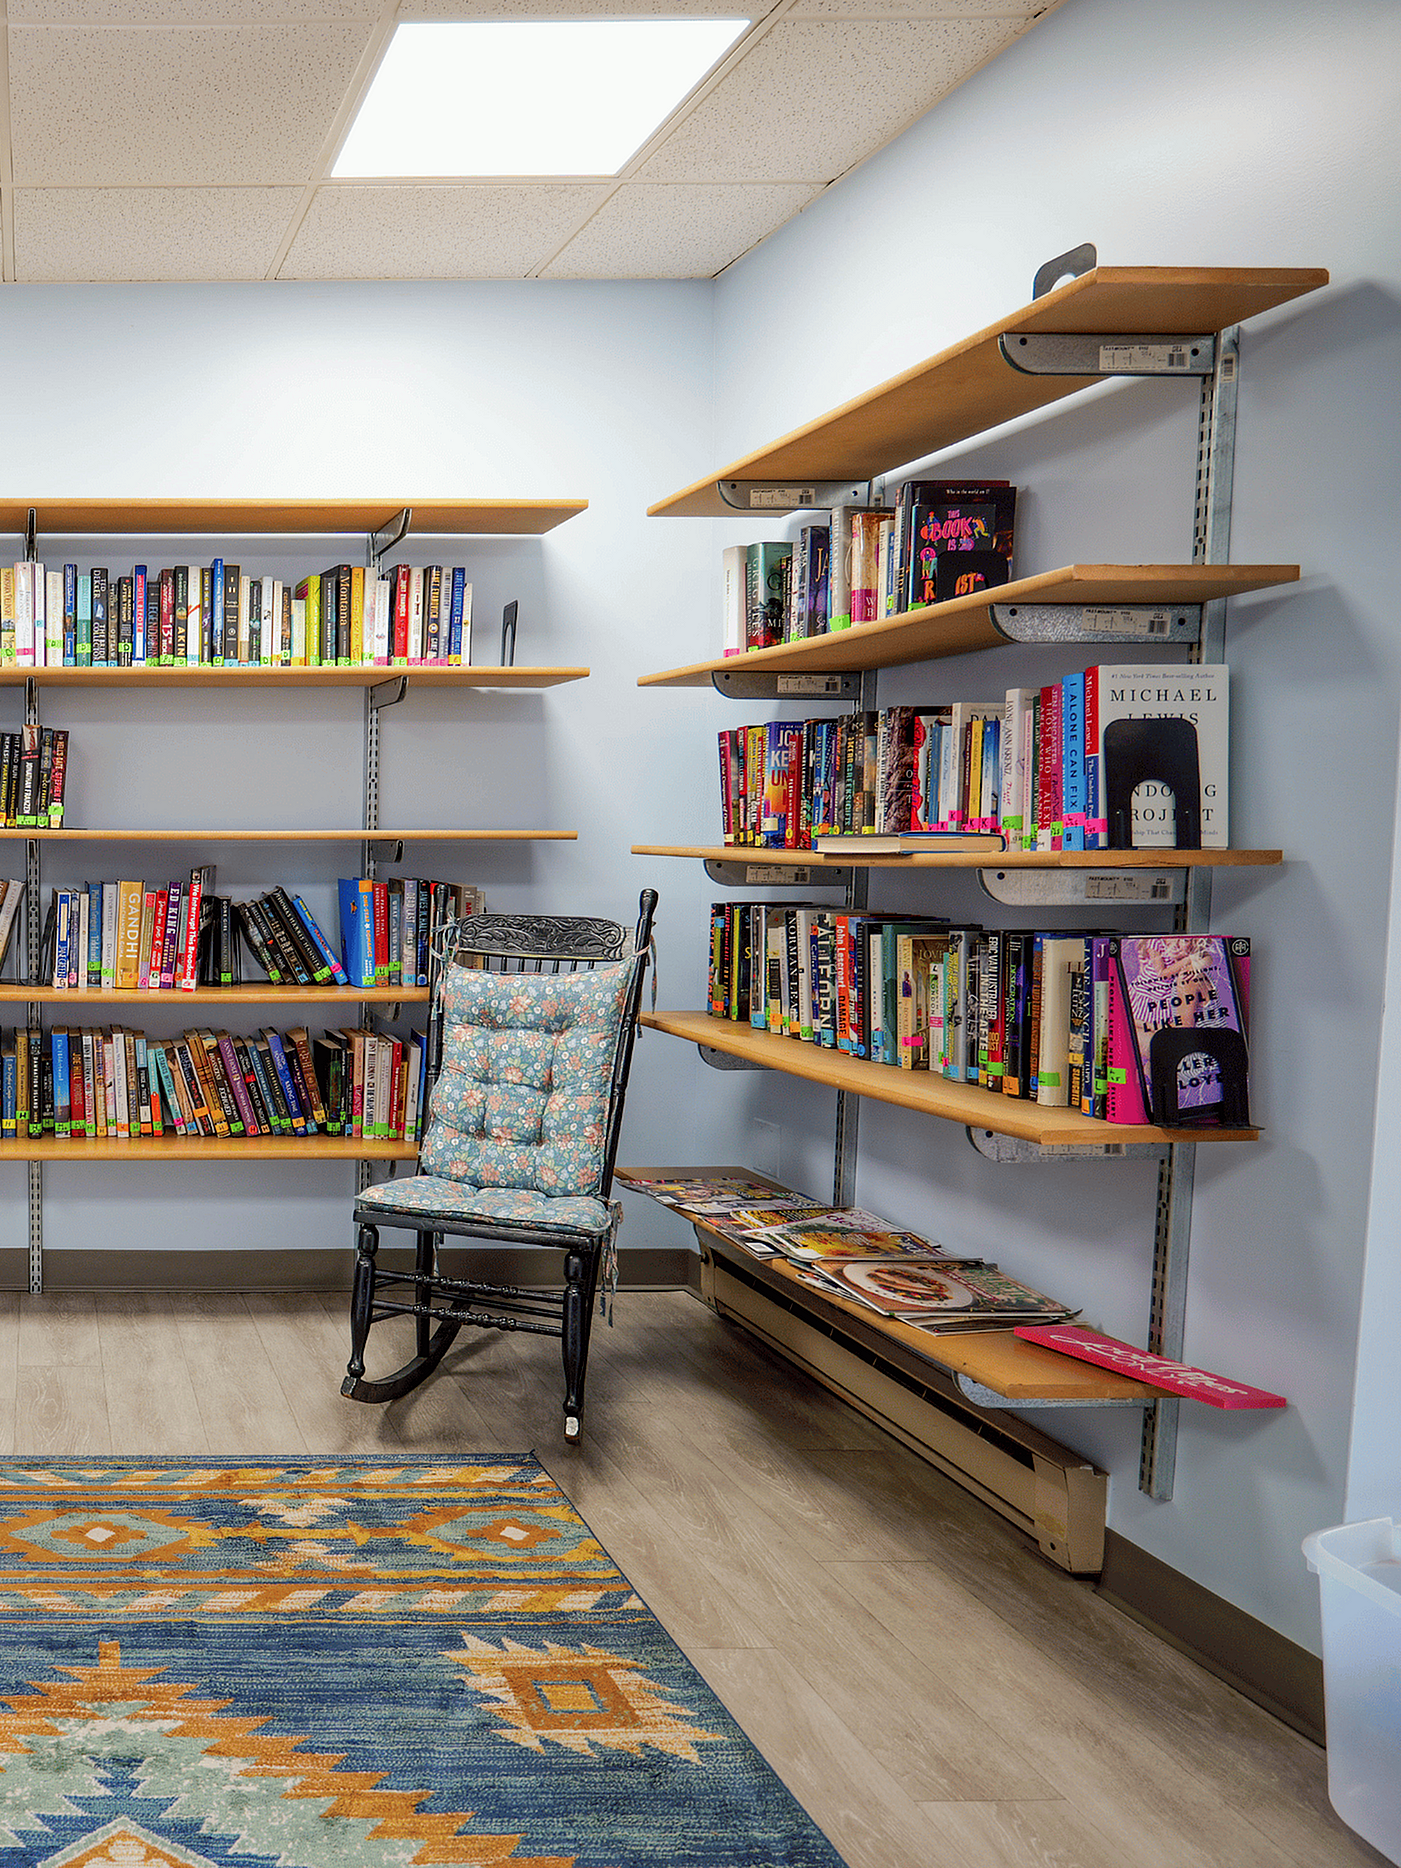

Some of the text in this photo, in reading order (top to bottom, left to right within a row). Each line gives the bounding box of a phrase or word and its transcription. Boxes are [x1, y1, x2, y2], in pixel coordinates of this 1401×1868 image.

[931, 517, 972, 541] BOOK
[947, 510, 960, 519] THIS
[947, 539, 957, 551] IS
[340, 575, 350, 625] Montana
[751, 558, 760, 637] GREG ILES
[148, 602, 158, 657] LEGENDBORN
[1110, 689, 1217, 702] MICHAEL
[23, 762, 34, 814] JONATHAN FRANZEN
[1070, 785, 1078, 808] FIX
[126, 893, 141, 958] GANDHI
[167, 888, 179, 934] ED KING
[186, 885, 200, 979] We Interrupt This Broadcas
[837, 925, 847, 1035] John Lescroart DAMAGE
[988, 936, 997, 1020] ERIC VAN LUSTBADER
[1143, 1007, 1230, 1033] LIKE HER
[1148, 989, 1217, 1013] PEOPLE
[219, 1087, 231, 1116] ECHOED
[1071, 1068, 1080, 1106] SLAUGHTER
